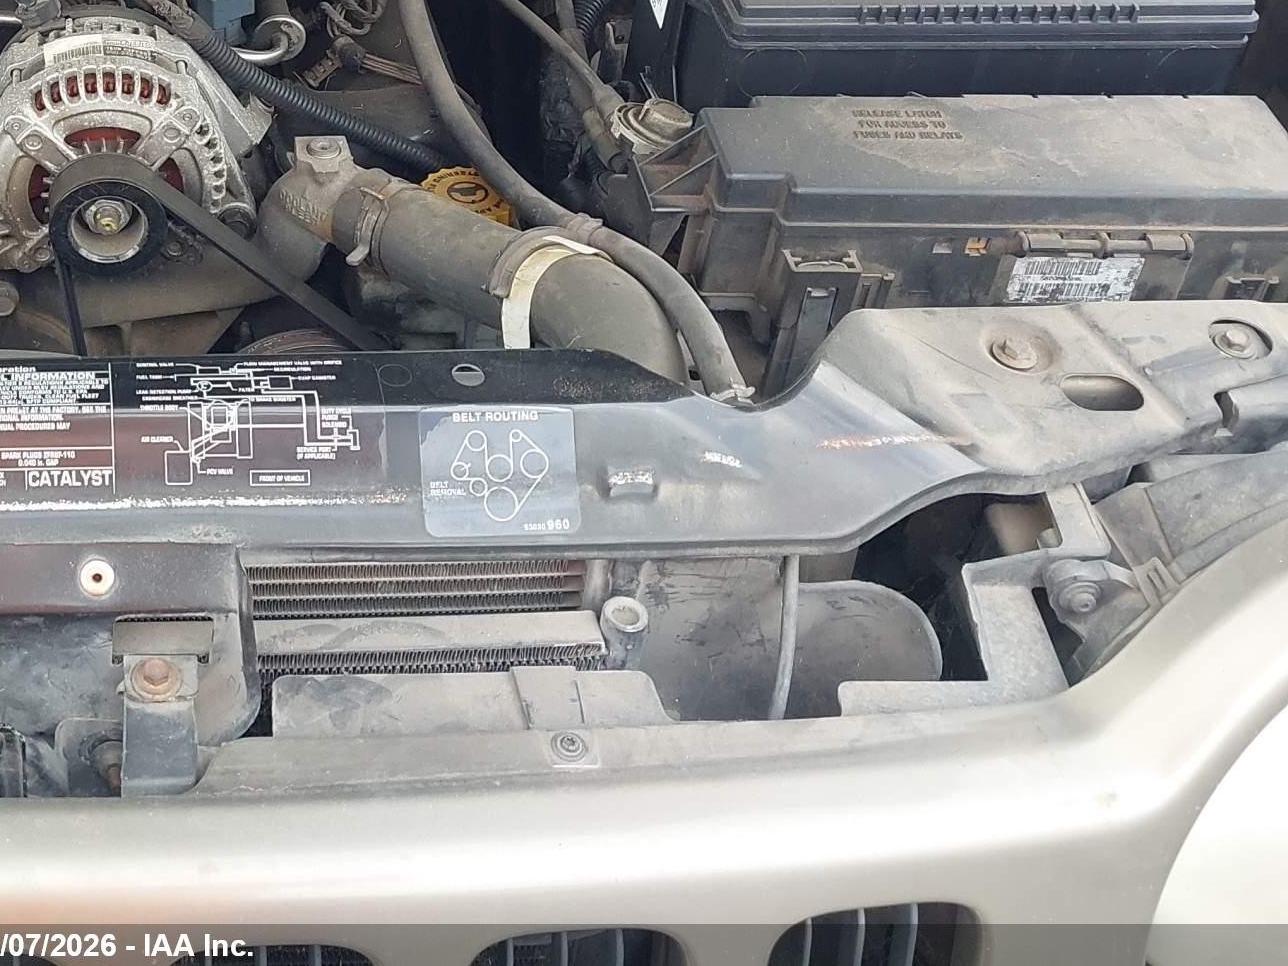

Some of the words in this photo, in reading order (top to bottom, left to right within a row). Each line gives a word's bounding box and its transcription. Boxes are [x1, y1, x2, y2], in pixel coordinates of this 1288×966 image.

[930, 120, 947, 129] TO
[11, 372, 96, 380] INFORMATION
[452, 412, 482, 422] BELT
[485, 411, 538, 422] ROUTING
[29, 470, 112, 486] CATALYST
[430, 488, 466, 496] REMOVAL
[546, 518, 570, 530] 960
